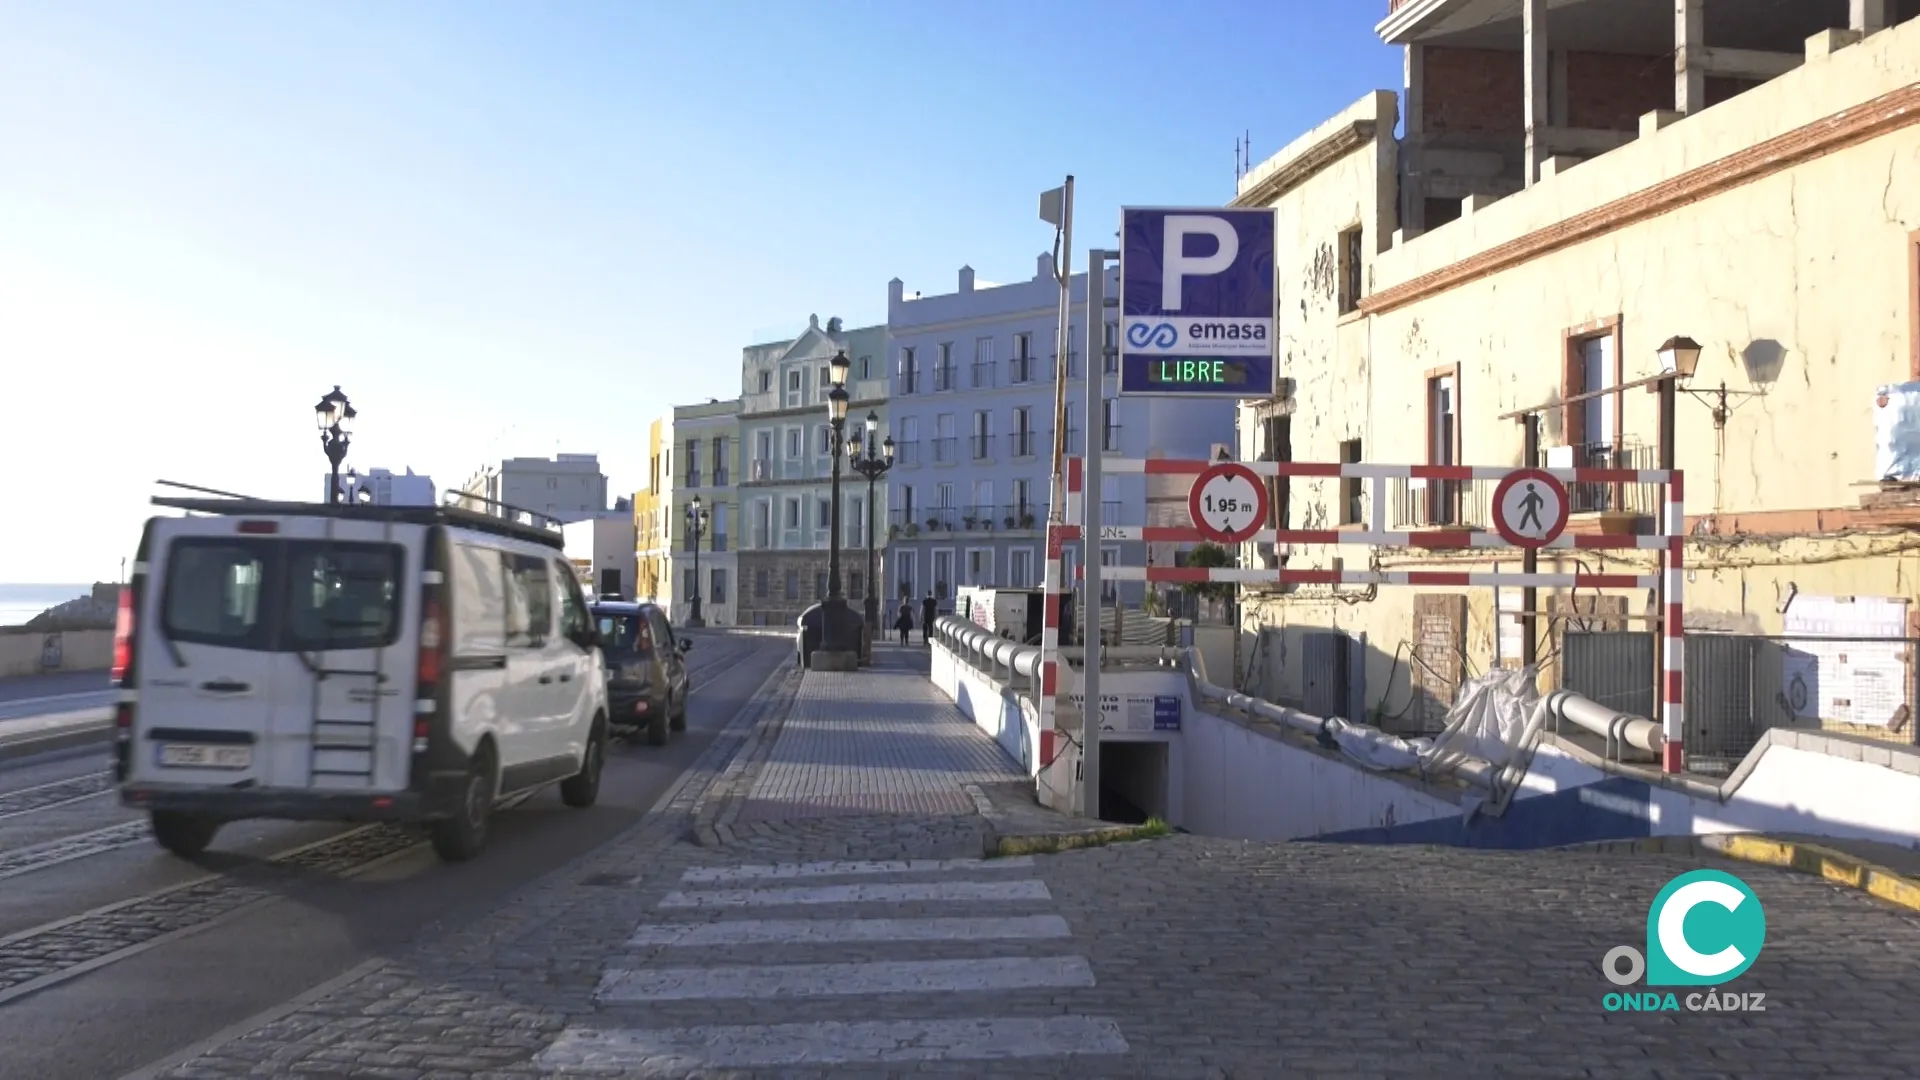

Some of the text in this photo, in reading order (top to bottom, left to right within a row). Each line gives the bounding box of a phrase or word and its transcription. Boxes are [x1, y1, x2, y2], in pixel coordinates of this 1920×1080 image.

[1161, 214, 1239, 310] P
[1188, 323, 1266, 340] emasa
[1160, 360, 1225, 383] LIBRE
[1204, 494, 1252, 513] 1.95 m
